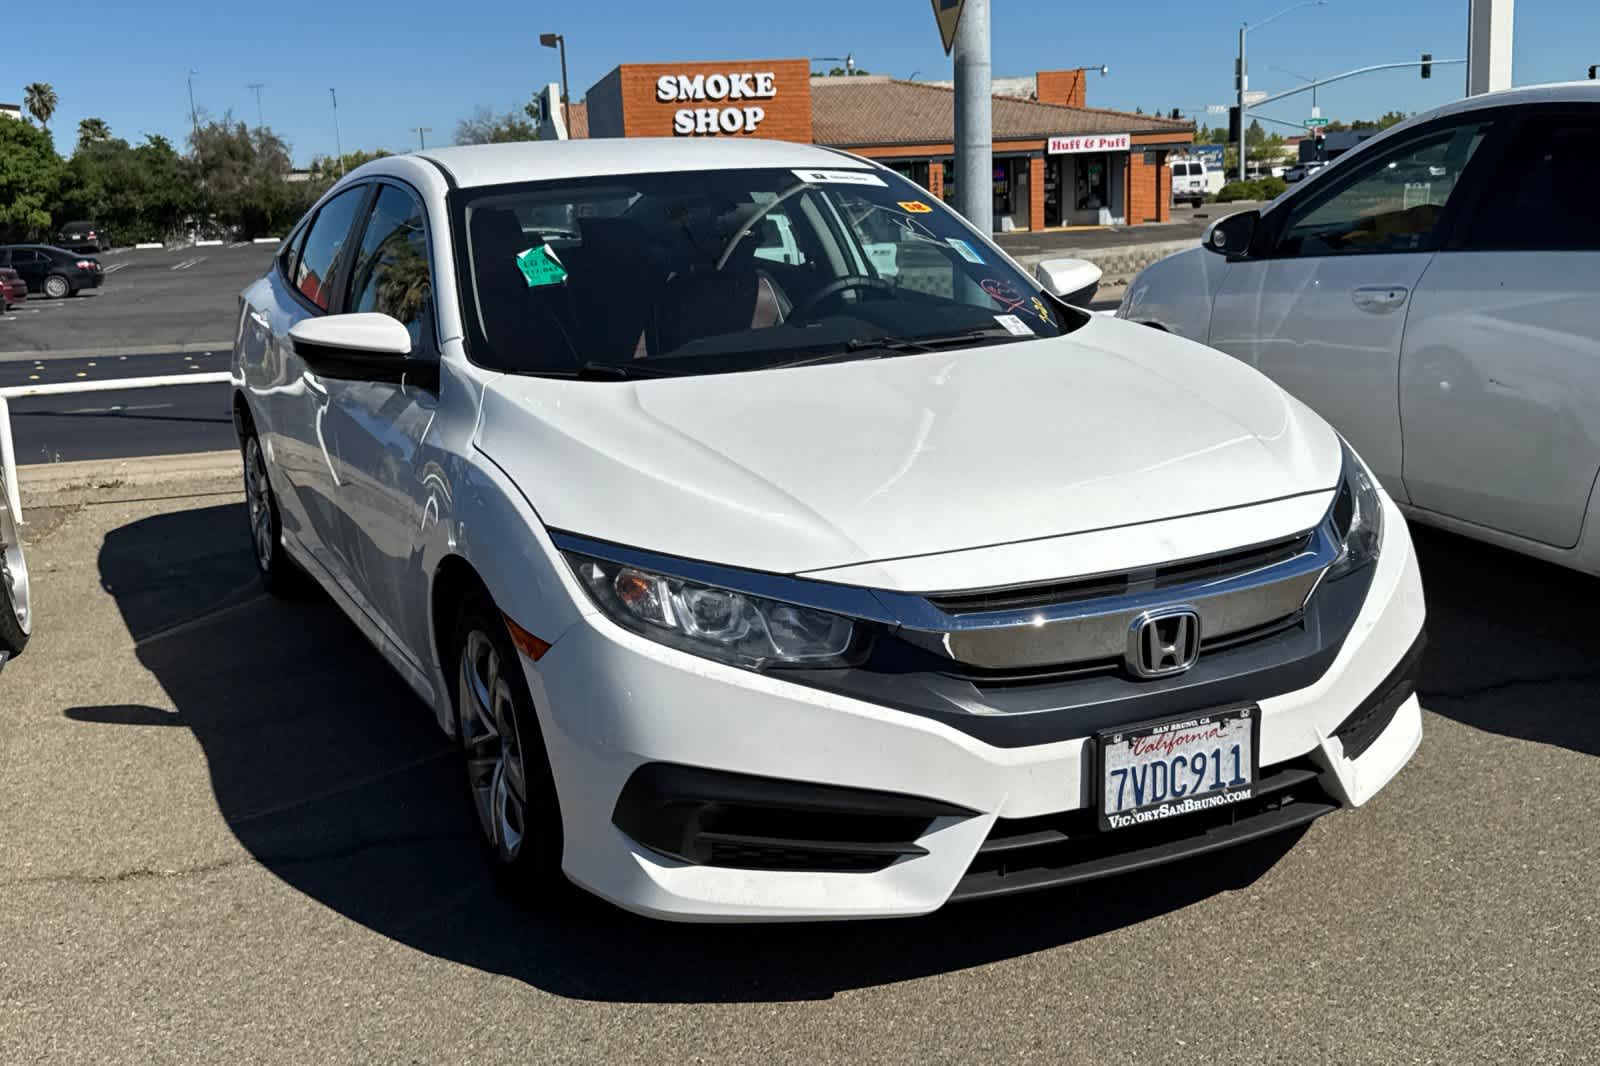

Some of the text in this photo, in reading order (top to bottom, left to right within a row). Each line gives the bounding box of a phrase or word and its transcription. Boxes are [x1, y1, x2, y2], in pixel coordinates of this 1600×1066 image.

[656, 72, 777, 101] SMOKE
[674, 107, 765, 134] SHOP
[1052, 139, 1081, 150] Huff
[1099, 137, 1126, 148] Puff
[1132, 727, 1228, 756] California
[1110, 744, 1246, 811] 7VDC911
